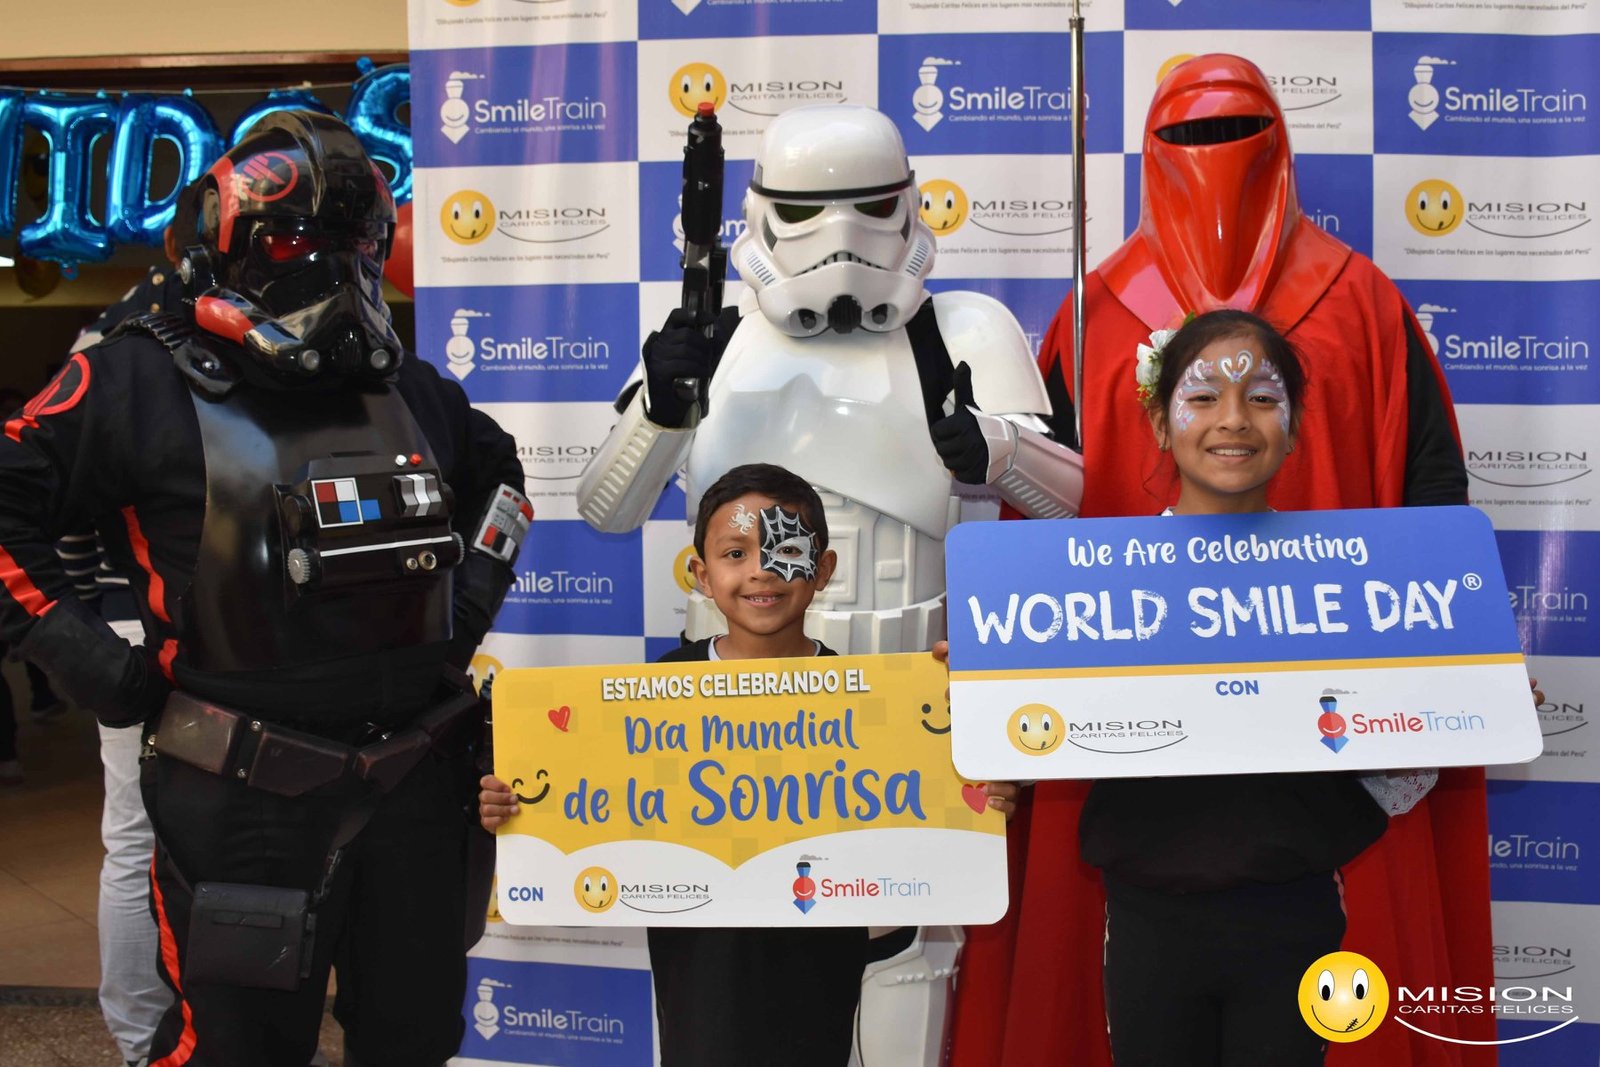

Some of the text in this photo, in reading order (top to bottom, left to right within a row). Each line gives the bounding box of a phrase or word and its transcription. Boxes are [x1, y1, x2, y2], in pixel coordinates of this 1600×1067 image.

[731, 81, 843, 93] MISION
[1265, 76, 1337, 86] SION
[789, 92, 843, 100] FELICES
[1445, 86, 1586, 112] SmileTrain
[475, 96, 606, 123] SmileTrain
[500, 208, 605, 220] MISION
[1468, 202, 1586, 213] MISION
[1529, 213, 1587, 221] FELICES
[480, 337, 609, 360] SmileTrain
[1445, 334, 1588, 360] SmileTrain
[1468, 451, 1587, 462] MISION
[1067, 533, 1369, 568] We Are Celebrating
[967, 589, 1168, 645] WORLD
[1187, 583, 1349, 638] SMILE
[602, 668, 871, 701] ESTAMOS CELEBRANDO EL
[1215, 680, 1260, 696] CON
[701, 708, 860, 753] Mundial
[1069, 719, 1182, 732] MISION
[1352, 710, 1485, 734] SmileTrain
[1130, 730, 1184, 738] FELICES
[563, 759, 927, 827] de la Sonrisa
[1488, 834, 1579, 859] leTrain
[508, 886, 544, 902] CON
[621, 884, 709, 893] MISION
[821, 877, 931, 898] SmileTrain
[1492, 945, 1571, 958] SION
[503, 1005, 624, 1034] SmileTrain
